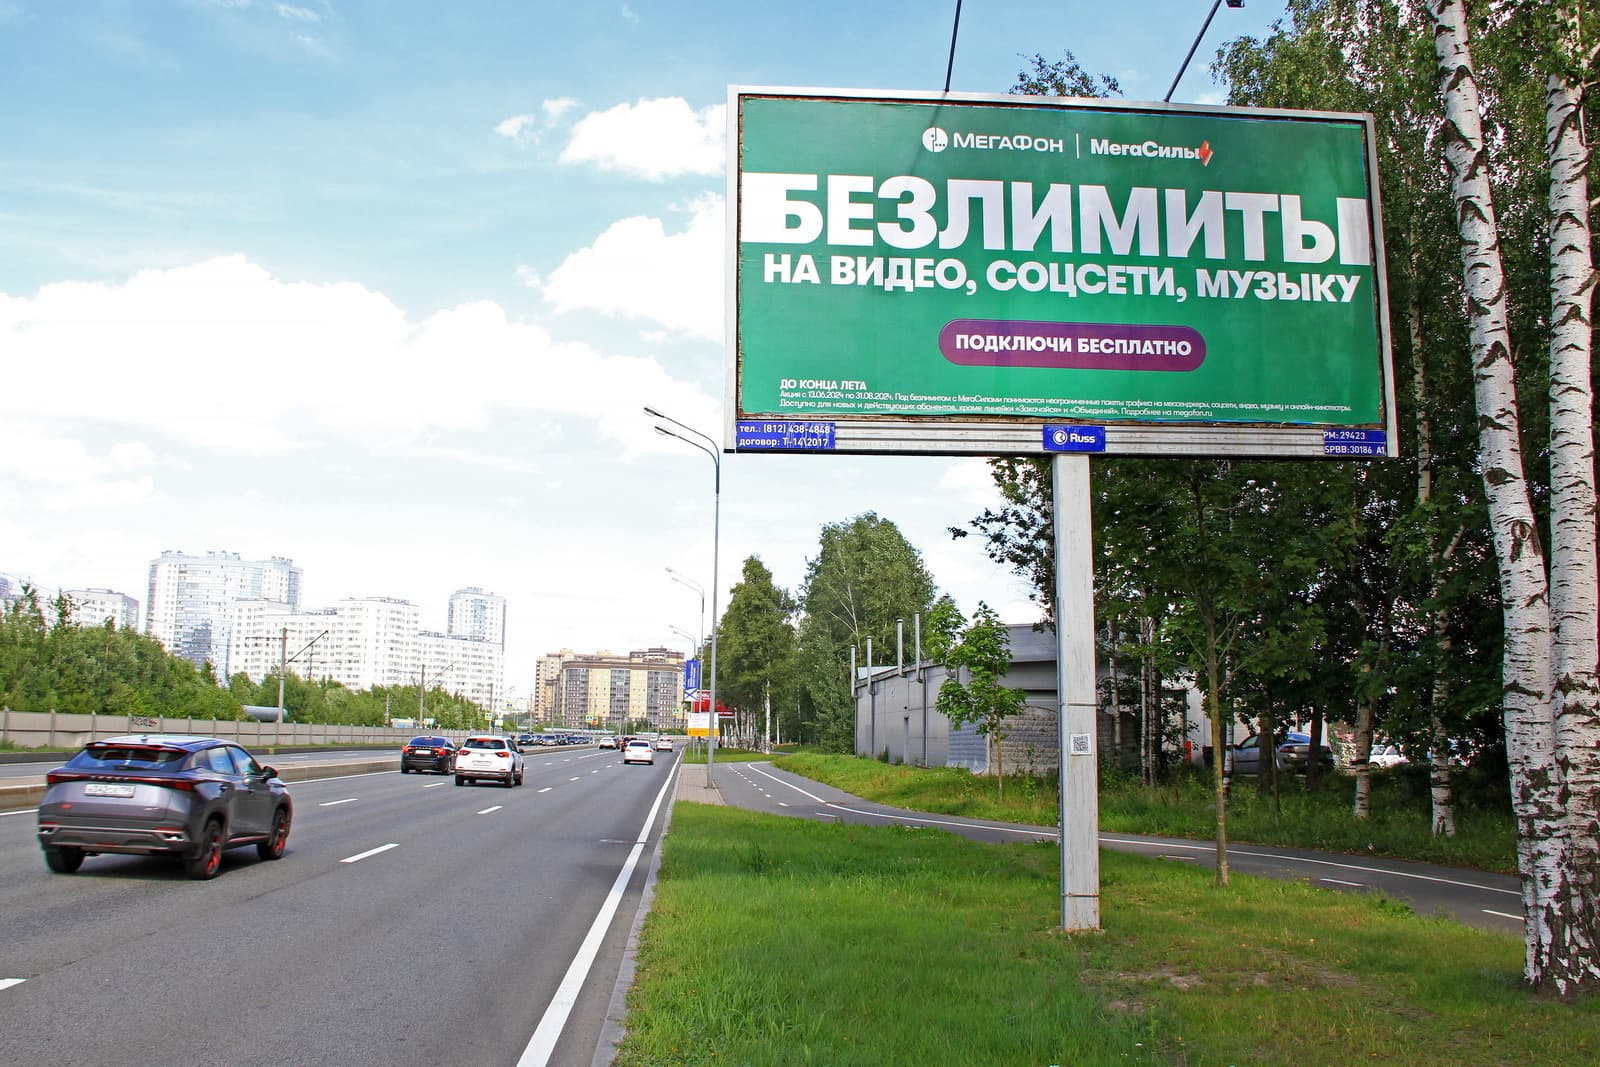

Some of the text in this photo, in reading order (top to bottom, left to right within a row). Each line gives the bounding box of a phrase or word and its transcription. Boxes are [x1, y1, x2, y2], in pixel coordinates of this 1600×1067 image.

[1090, 138, 1201, 161] МегаСилы
[741, 172, 1370, 266] БЕЗЛИМИТЫ
[764, 253, 1361, 303] НА ВИДЕО, СОЦСЕТИ, МУЗЫКУ
[955, 333, 1193, 356] ПОДКЛЮЧИ БЕСПЛАТНО
[779, 379, 868, 391] ДО КОНЦА ЛЕТА
[807, 391, 843, 399] 13.06.2024
[779, 399, 817, 408] Доступно
[1172, 409, 1213, 417] megafon.ru
[763, 424, 786, 433] (812)
[788, 425, 831, 434] 438-4848
[740, 438, 780, 447] договор:
[1070, 433, 1096, 443] Russ
[1324, 445, 1372, 454] SPBB:30186
